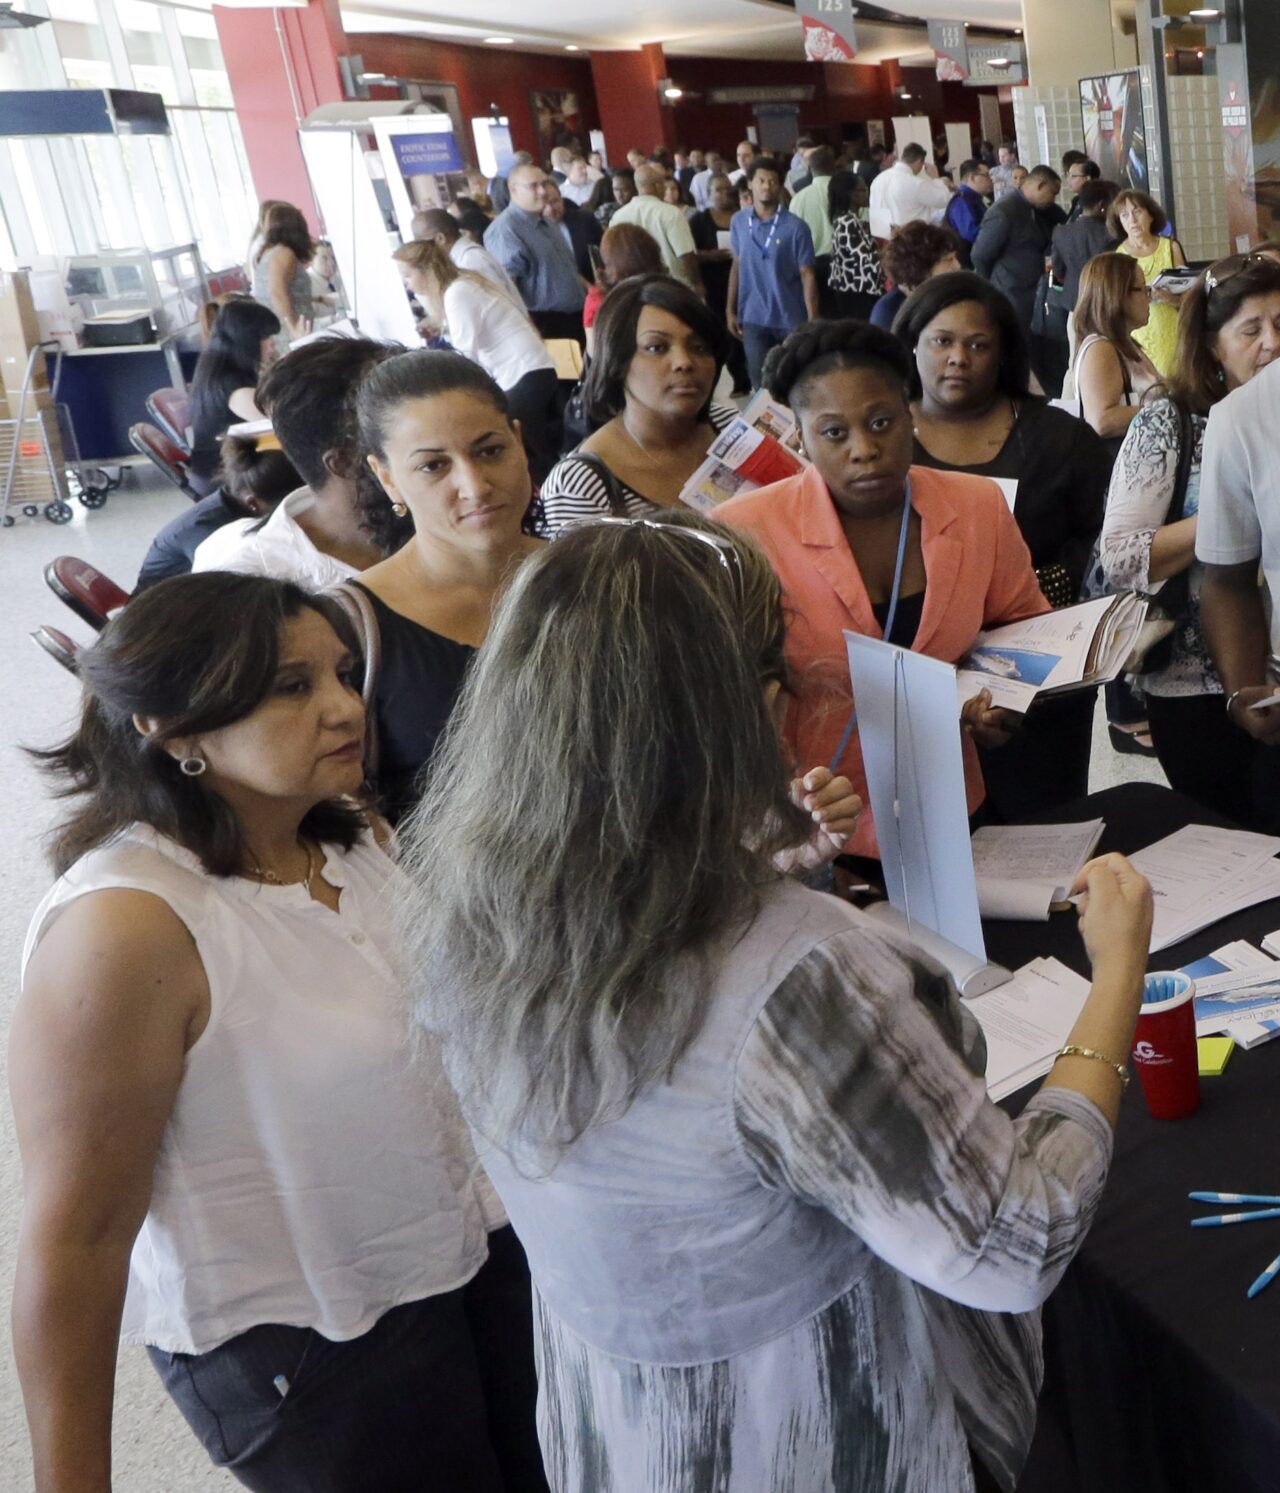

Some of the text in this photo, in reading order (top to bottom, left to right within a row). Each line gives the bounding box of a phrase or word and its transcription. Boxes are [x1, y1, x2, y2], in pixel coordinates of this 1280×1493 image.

[817, 0, 844, 11] 125
[942, 27, 959, 38] 125
[943, 38, 960, 48] 127
